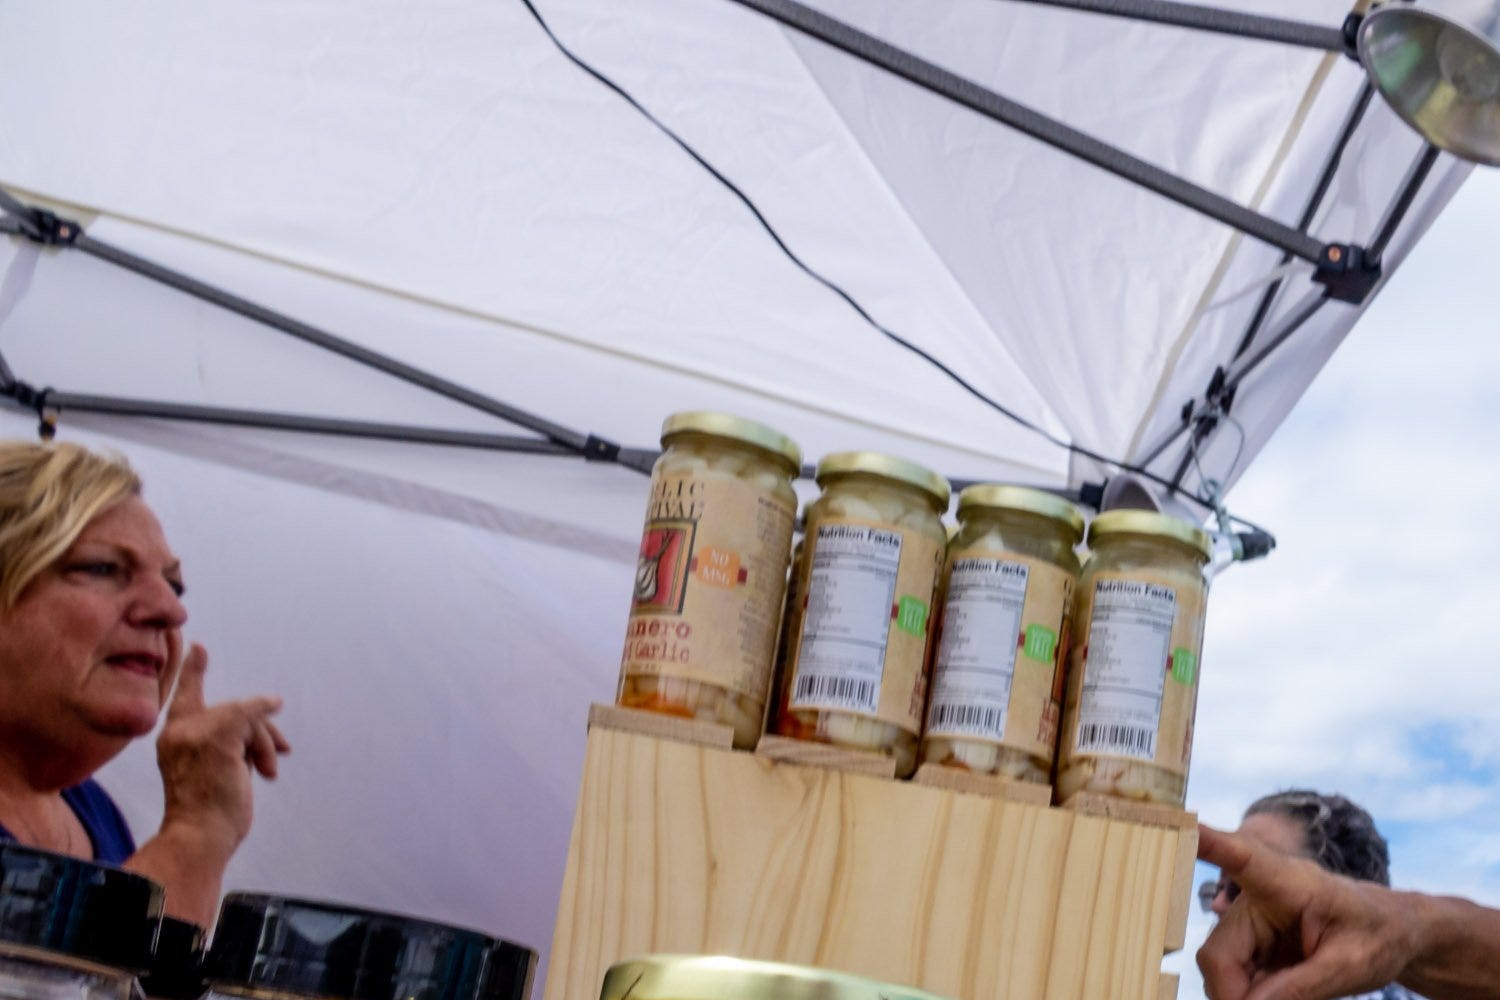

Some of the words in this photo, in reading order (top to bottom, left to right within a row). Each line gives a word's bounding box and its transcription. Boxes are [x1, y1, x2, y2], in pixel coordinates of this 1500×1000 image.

[818, 525, 864, 541] Nutrition
[867, 530, 900, 548] Facts
[711, 548, 729, 566] NO
[995, 562, 1026, 577] Facts
[1096, 581, 1142, 595] Nutrition
[1145, 583, 1174, 600] Facts
